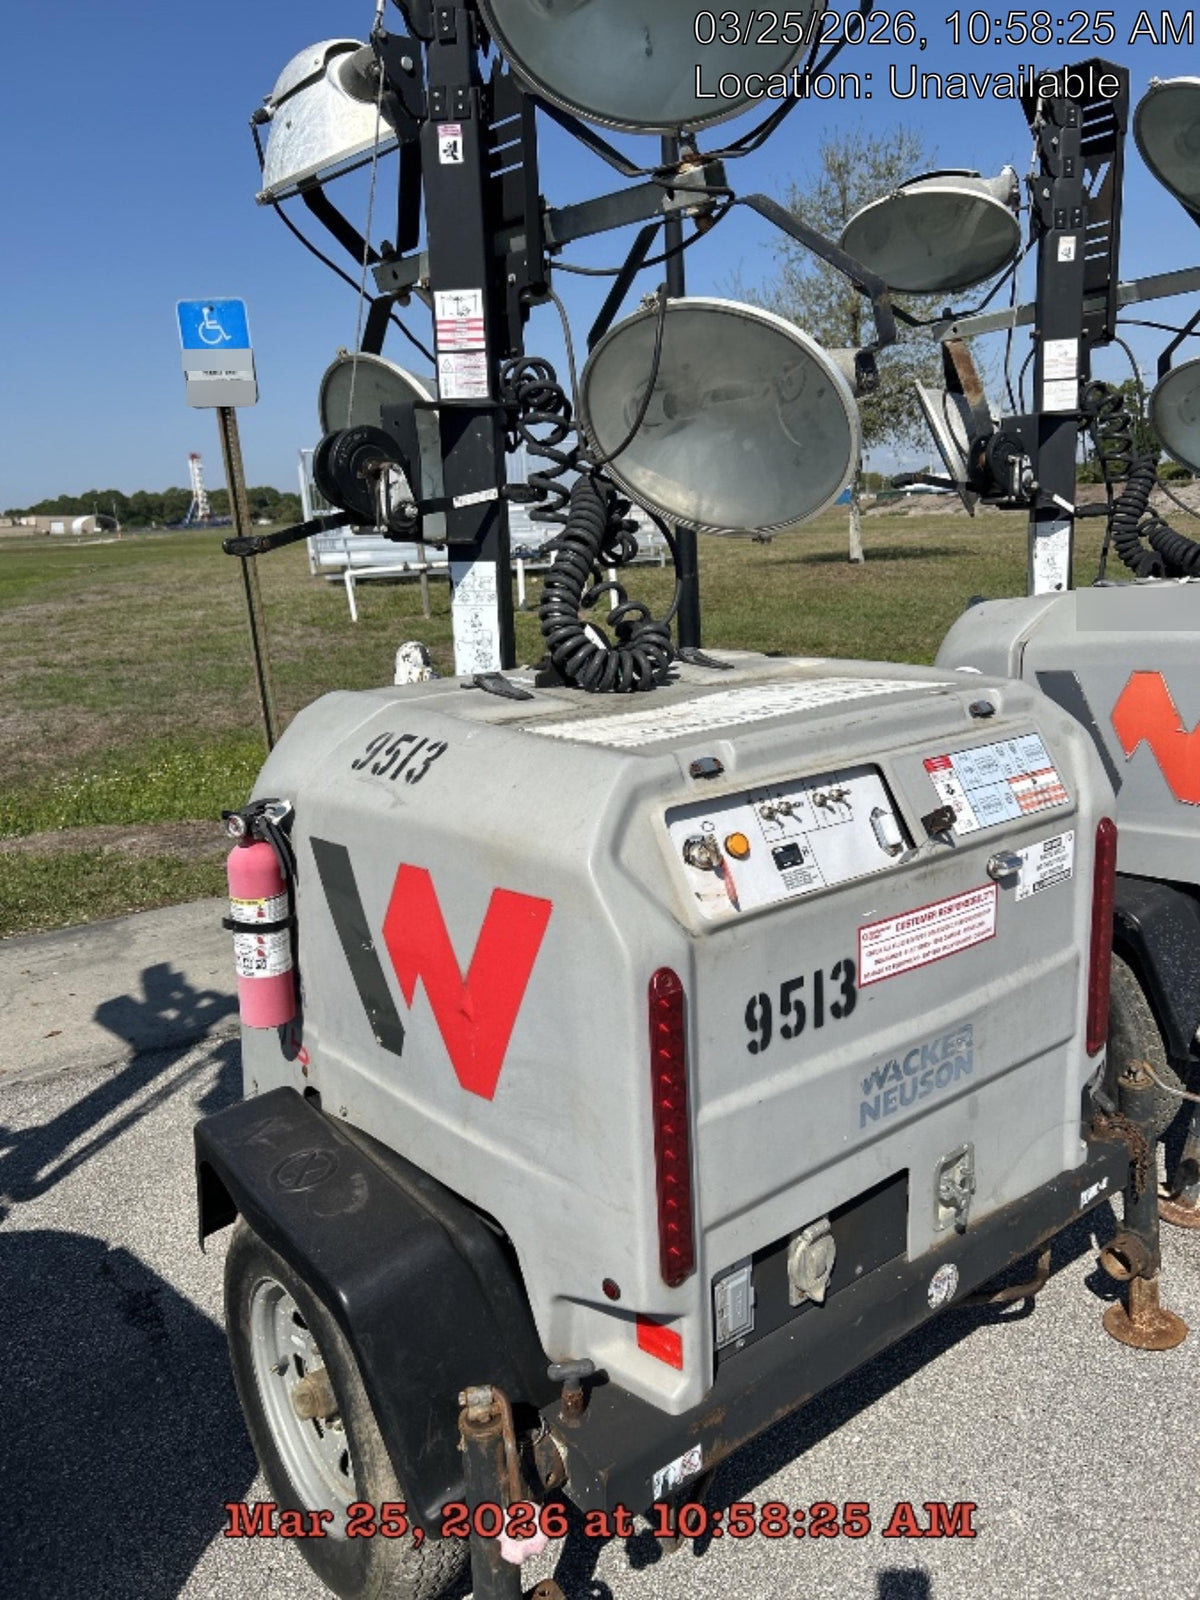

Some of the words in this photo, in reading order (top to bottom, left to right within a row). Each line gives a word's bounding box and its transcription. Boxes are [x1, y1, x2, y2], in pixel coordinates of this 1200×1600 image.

[351, 731, 449, 785] 9513
[895, 909, 938, 933] CUSTOMER
[744, 957, 858, 1055] 9513
[859, 1050, 974, 1129] NEUSON
[860, 1023, 975, 1096] WACKER
